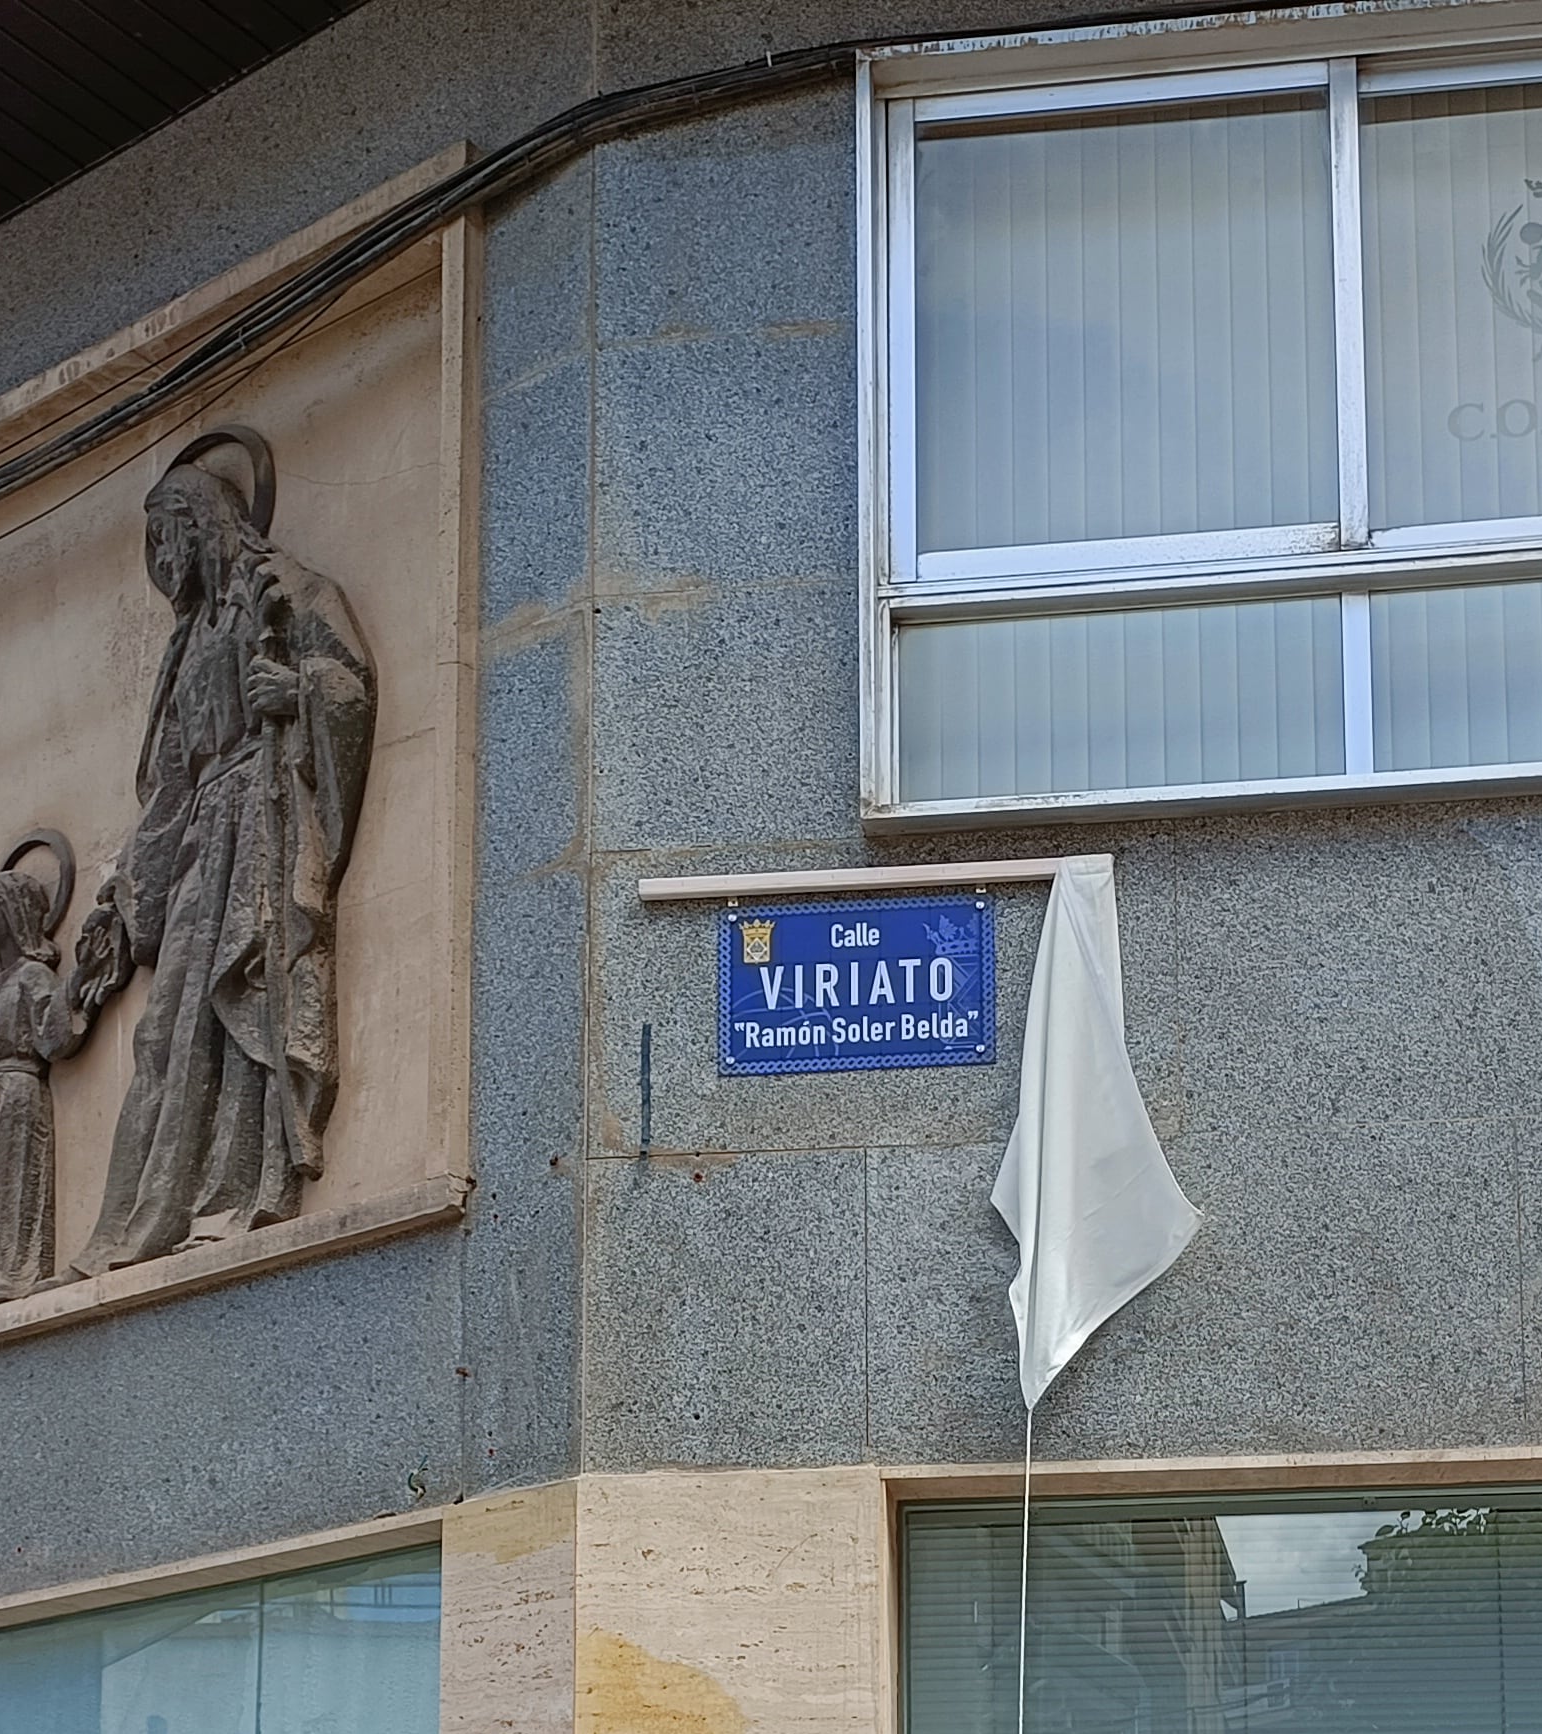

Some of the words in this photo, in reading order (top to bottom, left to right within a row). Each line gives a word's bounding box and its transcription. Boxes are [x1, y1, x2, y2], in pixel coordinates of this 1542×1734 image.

[830, 922, 881, 949] Calle
[759, 957, 954, 1010] VIRIATO
[831, 1016, 896, 1044] Soler
